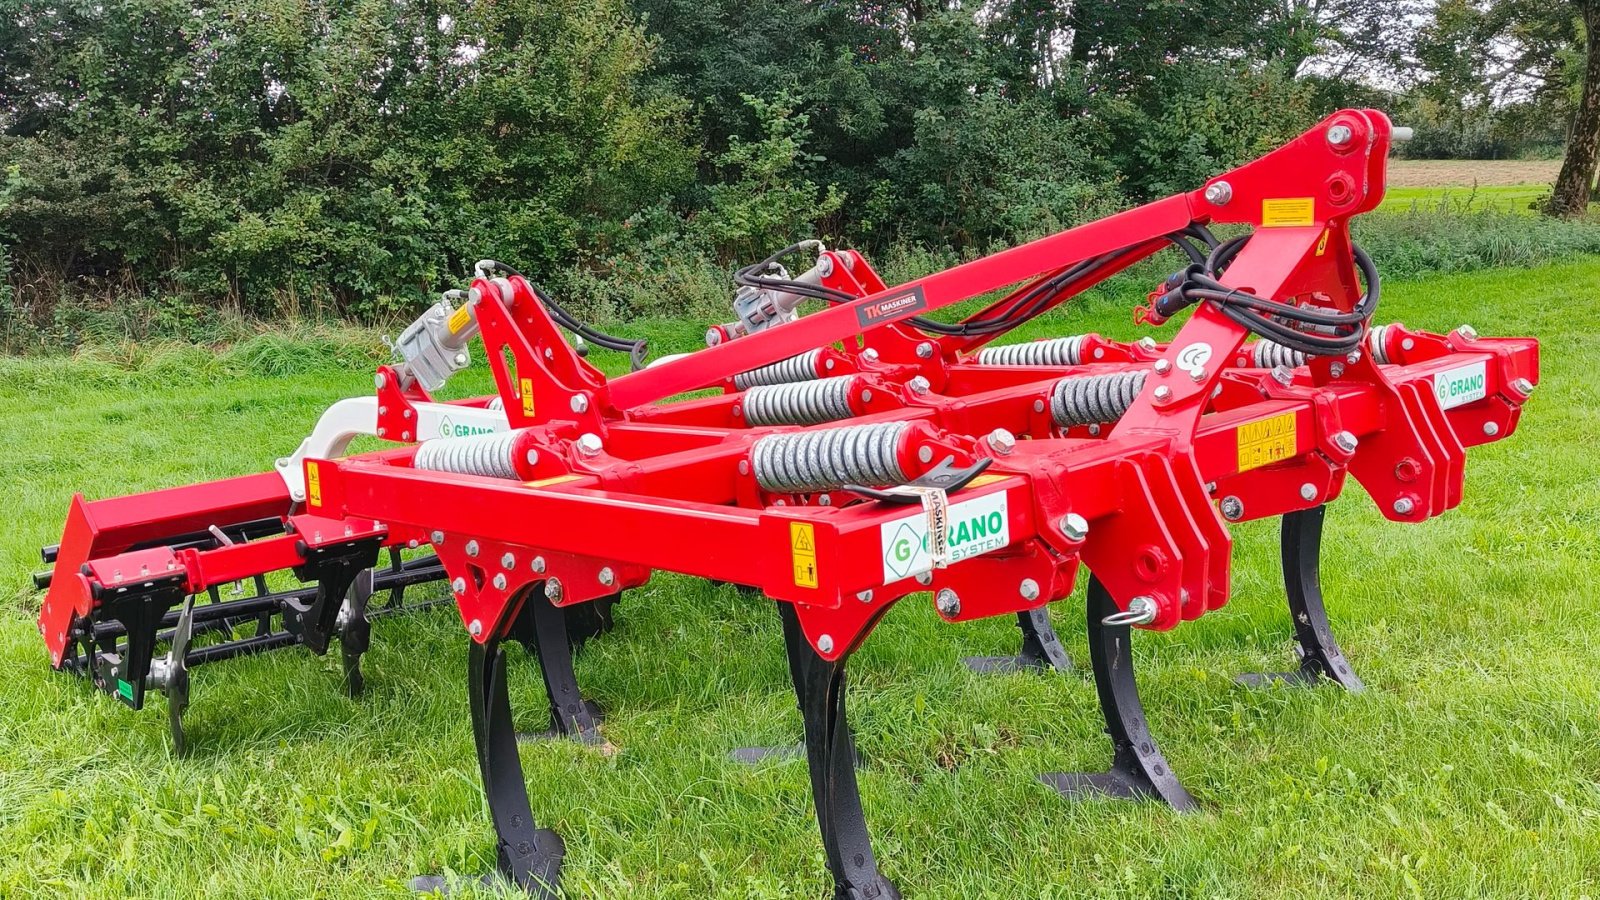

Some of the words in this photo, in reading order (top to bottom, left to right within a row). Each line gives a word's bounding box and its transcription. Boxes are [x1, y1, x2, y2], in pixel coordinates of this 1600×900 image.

[864, 304, 881, 319] TK
[881, 295, 917, 311] MASKINER
[1183, 348, 1207, 366] CE
[1450, 374, 1484, 397] GRANO
[895, 538, 911, 562] G
[952, 536, 1005, 560] SYSTEM
